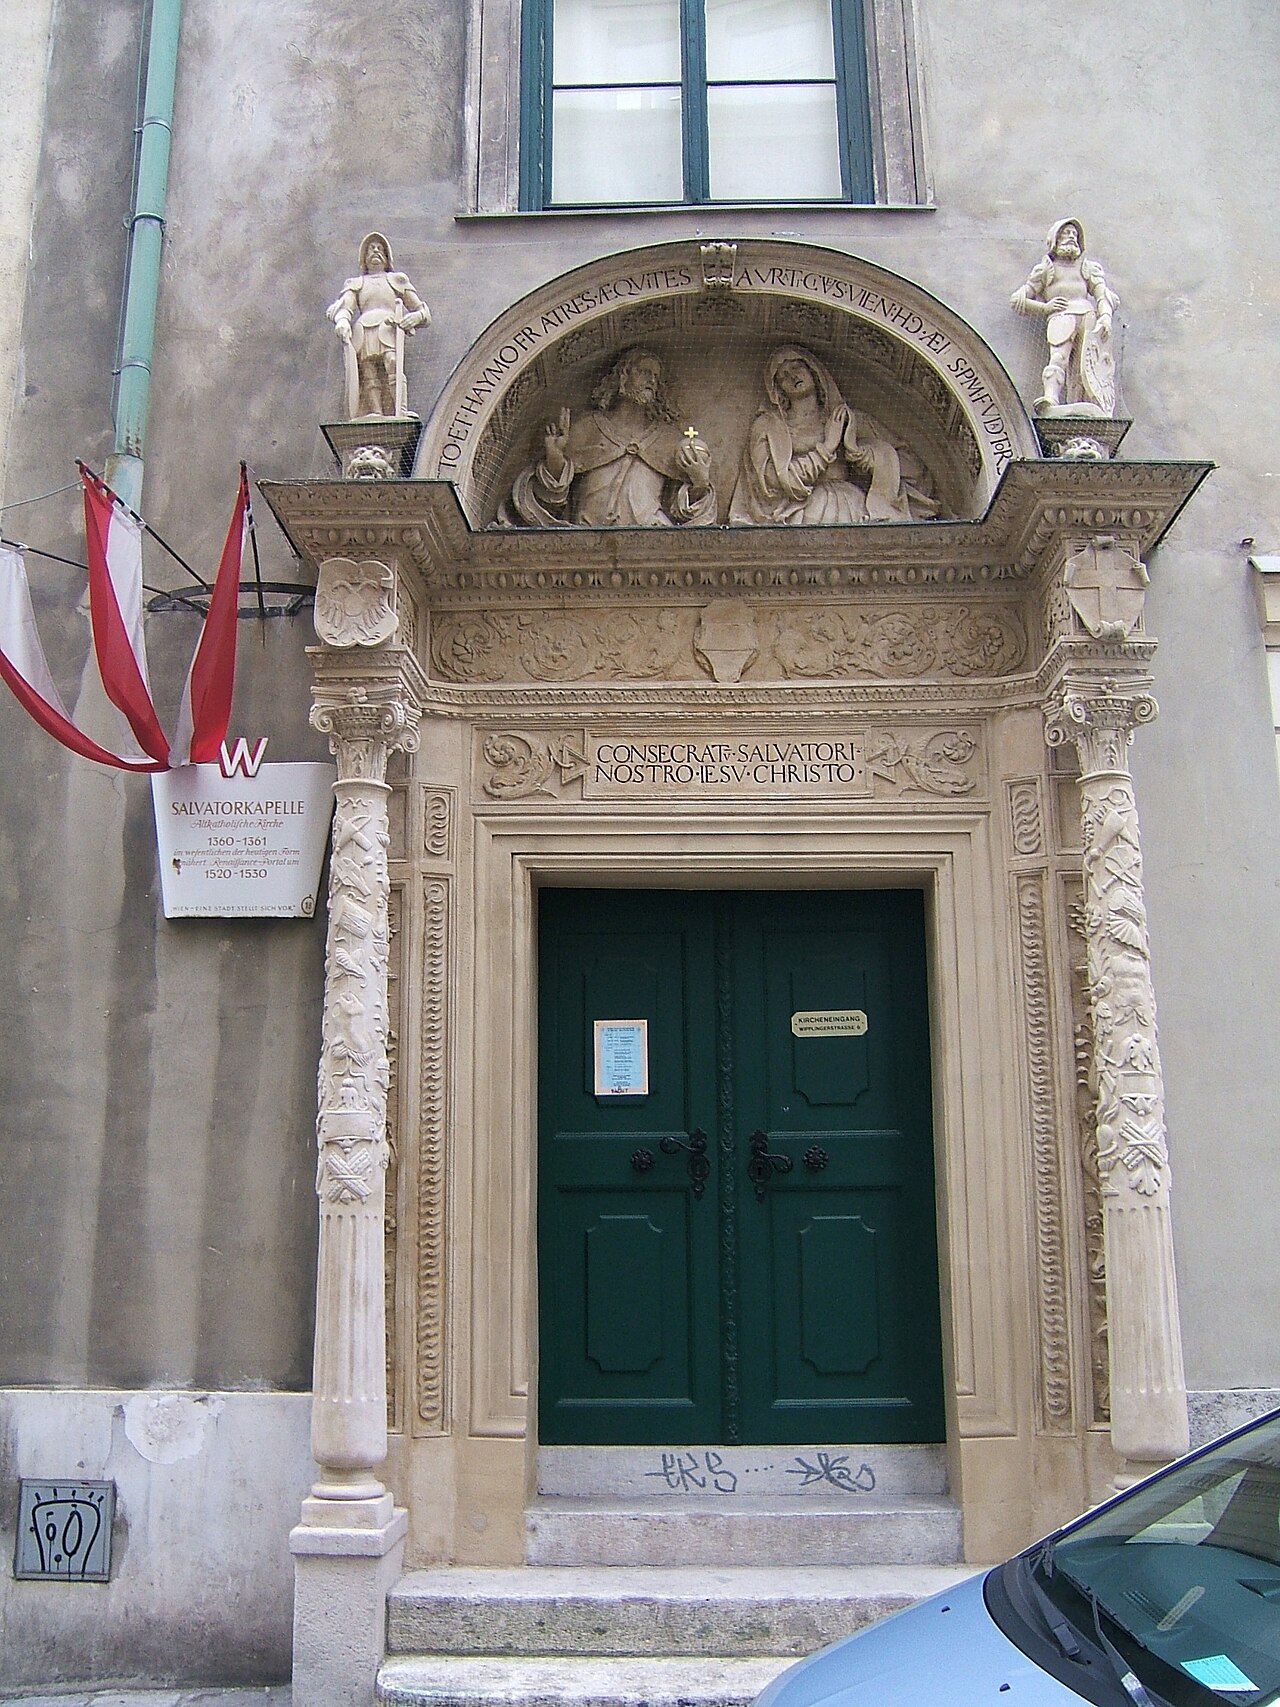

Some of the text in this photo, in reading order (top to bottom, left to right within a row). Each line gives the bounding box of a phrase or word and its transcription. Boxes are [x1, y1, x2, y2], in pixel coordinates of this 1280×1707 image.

[218, 737, 269, 778] W
[595, 764, 695, 783] NOSTRO
[753, 763, 855, 783] CHRISTO
[171, 801, 305, 816] SALVATORKAPELLE
[254, 818, 285, 830] Kirche
[232, 848, 245, 857] der
[798, 1015, 861, 1024] KIRCHENEINGANG
